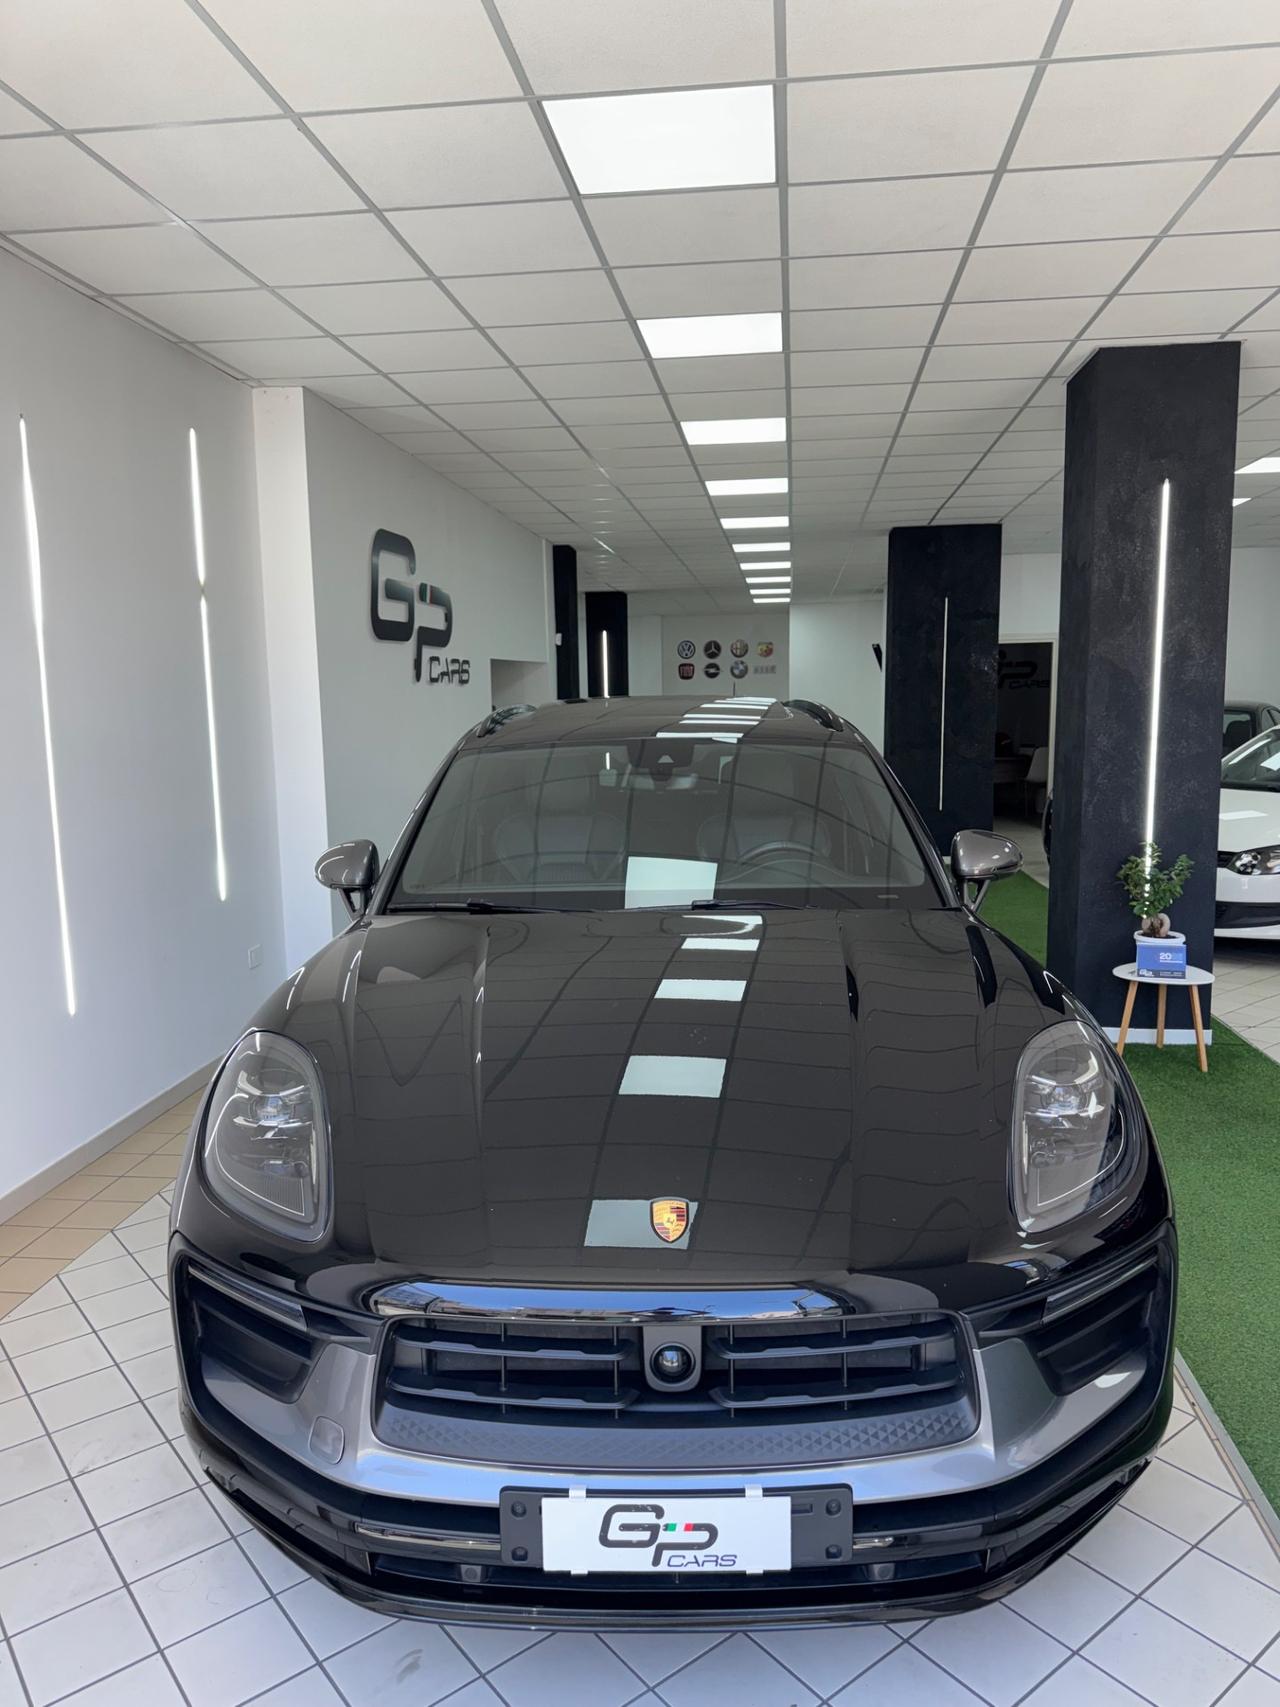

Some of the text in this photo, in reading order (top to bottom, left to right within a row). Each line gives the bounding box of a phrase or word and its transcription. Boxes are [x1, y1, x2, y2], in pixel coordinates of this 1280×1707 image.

[371, 528, 453, 683] GP
[428, 655, 471, 685] CARS
[599, 1503, 719, 1568] GP
[667, 1554, 738, 1568] CARS
